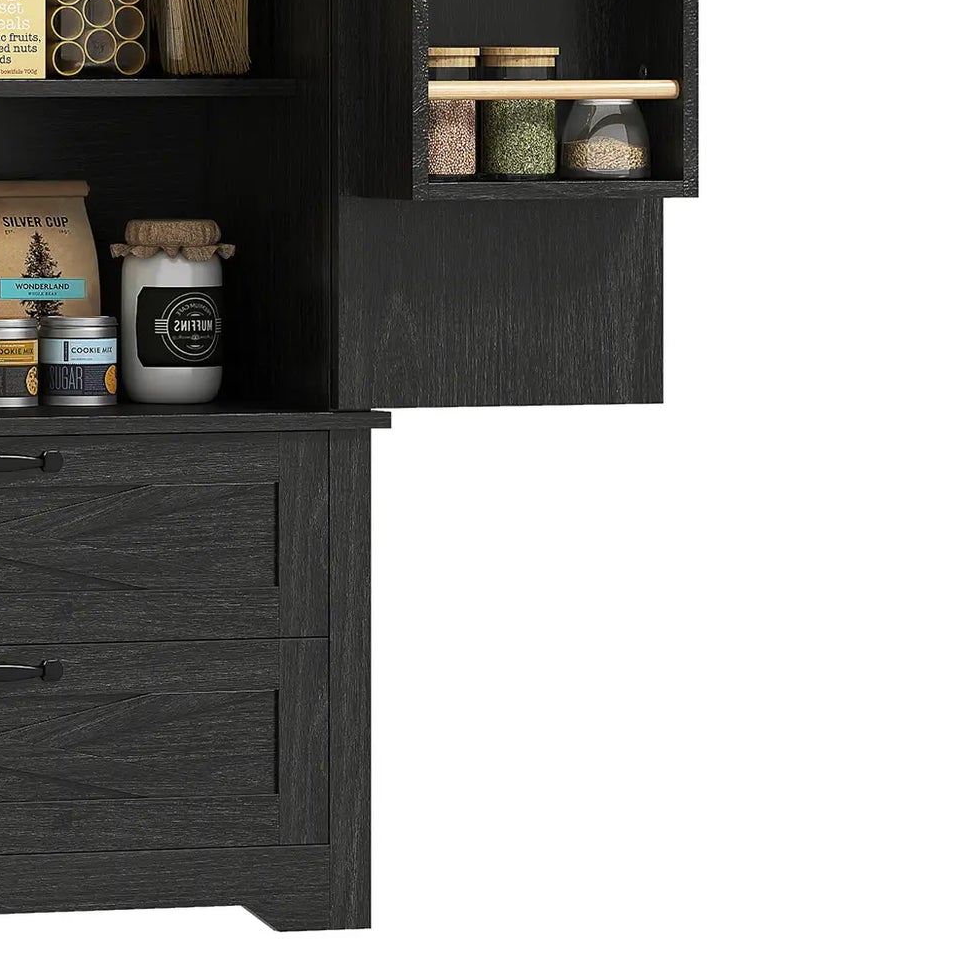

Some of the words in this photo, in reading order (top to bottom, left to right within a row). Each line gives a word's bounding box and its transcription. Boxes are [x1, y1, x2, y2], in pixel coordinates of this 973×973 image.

[9, 32, 41, 43] fruits,
[13, 44, 38, 53] nuts
[2, 217, 42, 227] SILVER
[45, 217, 69, 227] CUP
[49, 365, 83, 390] SUGAR
